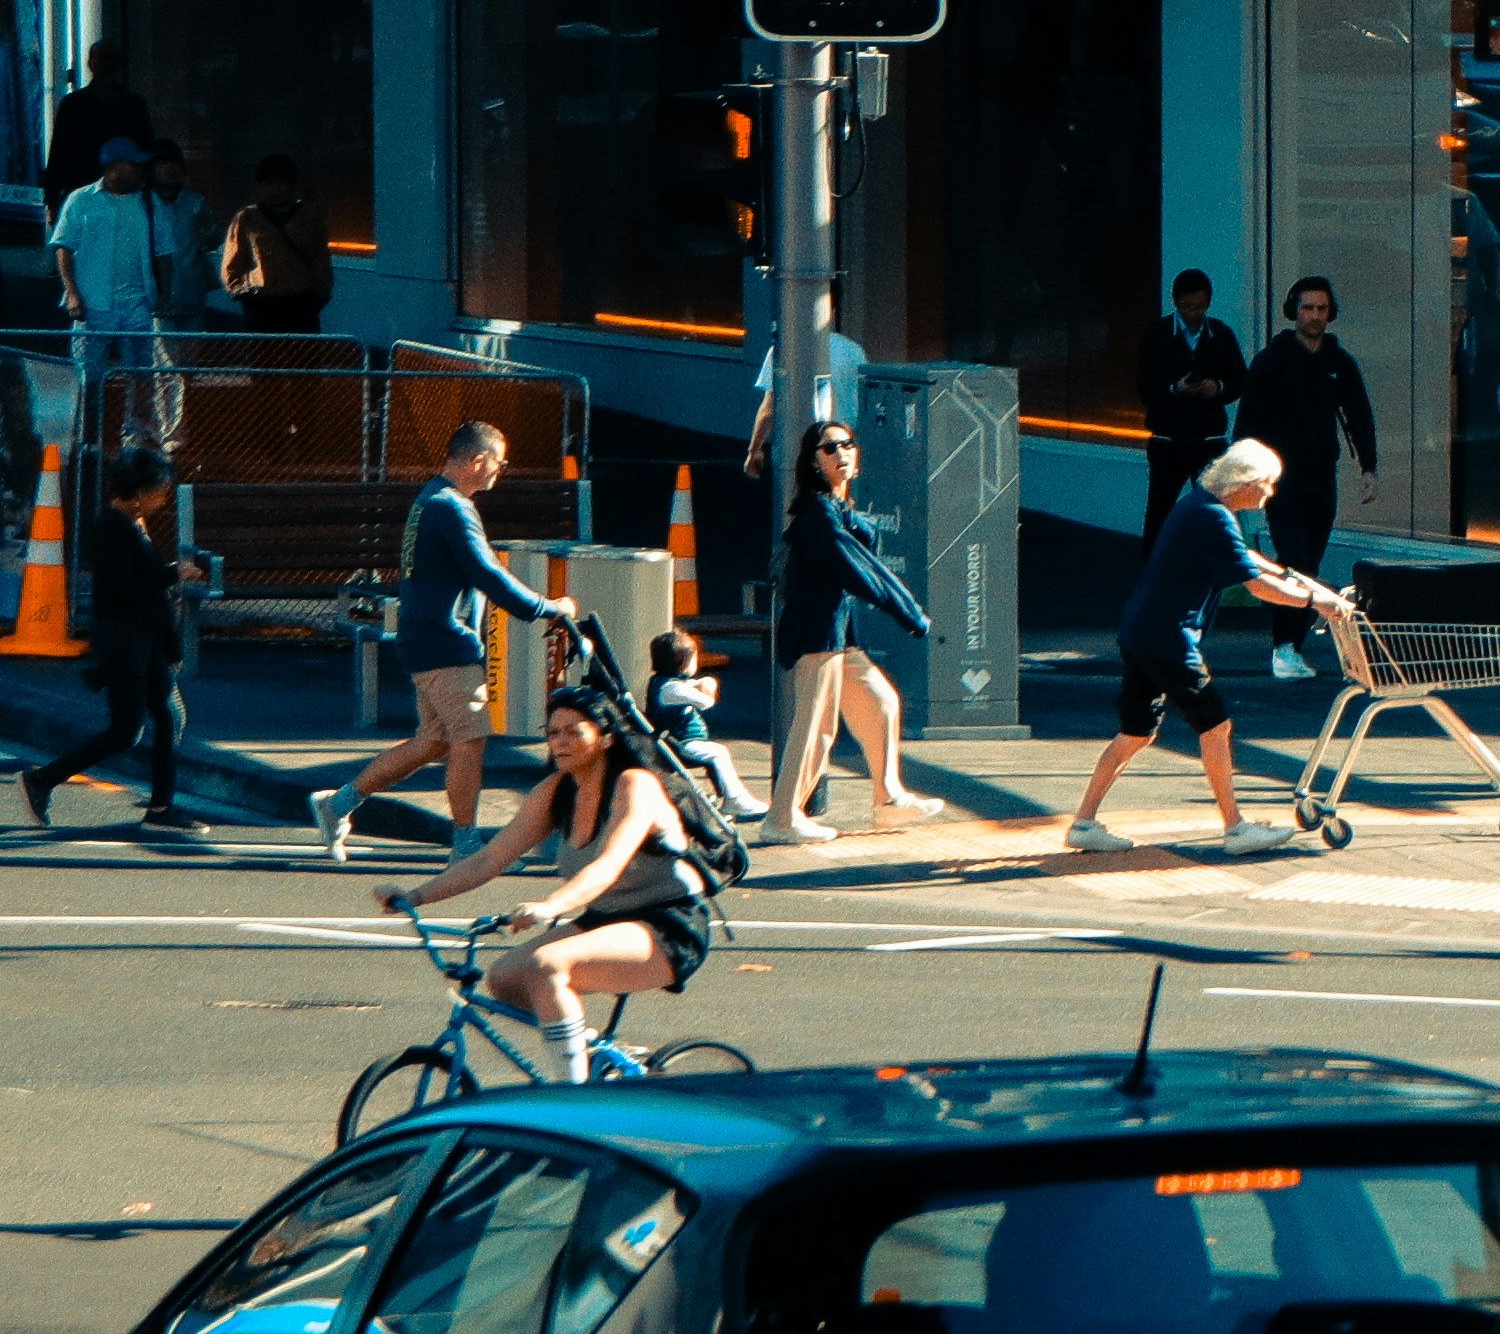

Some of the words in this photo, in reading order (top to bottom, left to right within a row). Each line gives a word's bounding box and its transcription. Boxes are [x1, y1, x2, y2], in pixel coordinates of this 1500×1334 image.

[967, 543, 981, 592] WORDS
[967, 594, 981, 633] YOUR
[967, 636, 981, 650] IN
